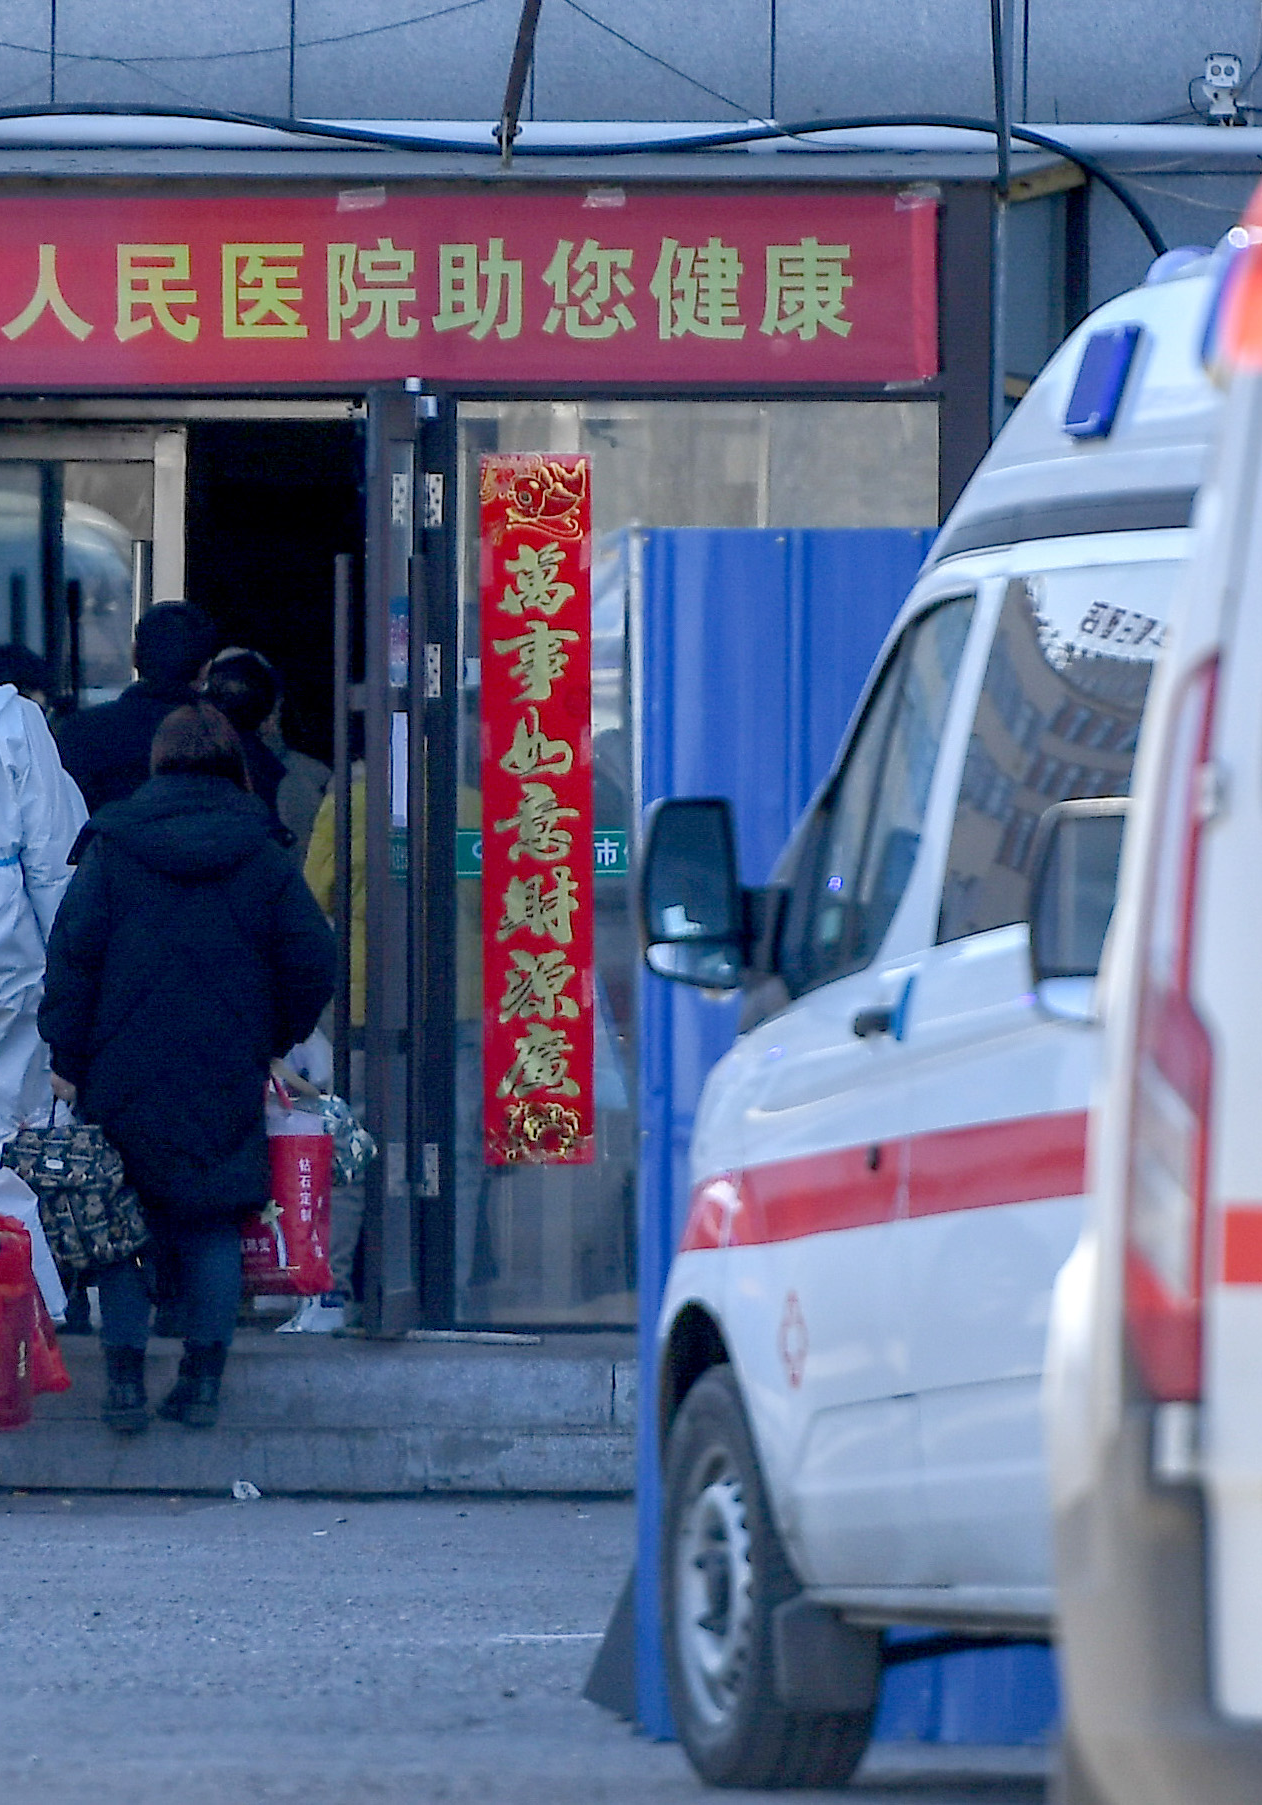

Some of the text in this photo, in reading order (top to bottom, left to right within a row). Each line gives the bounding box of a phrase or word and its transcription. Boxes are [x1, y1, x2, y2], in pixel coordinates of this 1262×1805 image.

[1, 237, 854, 343] 人民医院助您健康
